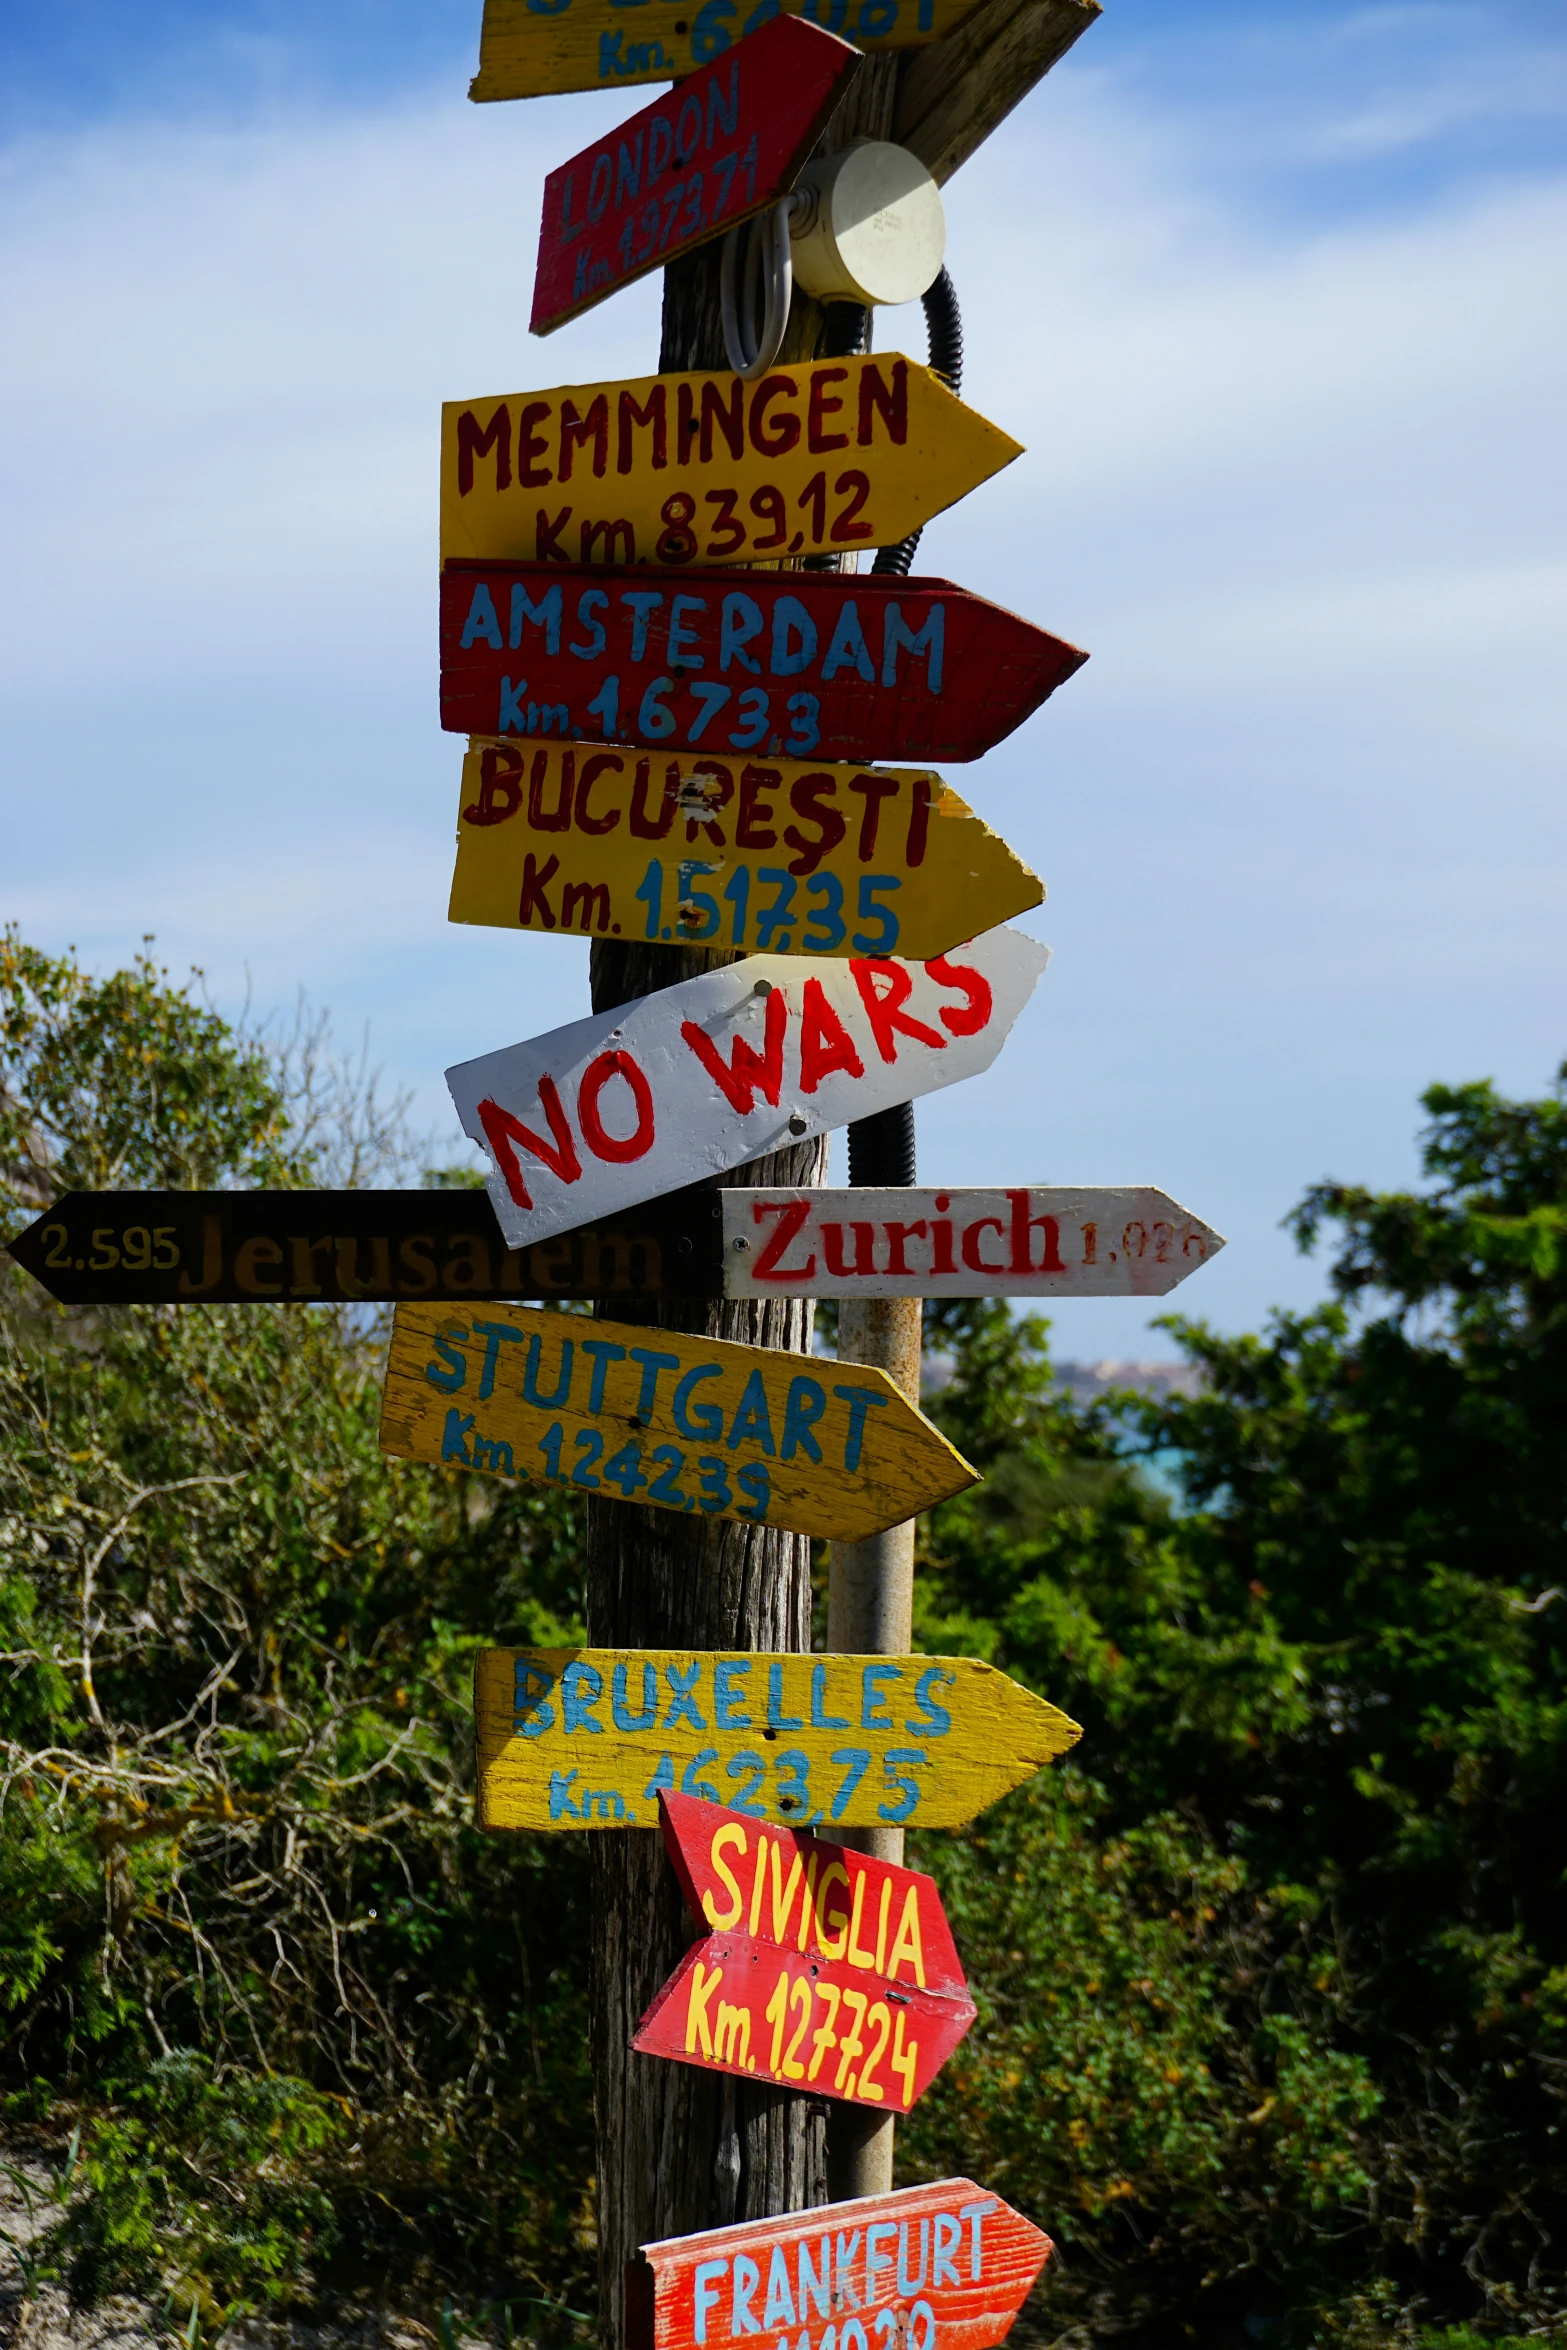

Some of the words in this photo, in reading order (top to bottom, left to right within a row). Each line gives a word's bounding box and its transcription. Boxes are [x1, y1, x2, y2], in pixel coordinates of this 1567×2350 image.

[599, 29, 675, 79] Km.
[561, 58, 739, 246] LONDON
[573, 245, 615, 301] Km.
[618, 132, 759, 271] 1.973,71
[456, 359, 908, 498] MEMMINGEN
[536, 506, 648, 564] Km.
[655, 469, 875, 565] 839,12
[460, 582, 946, 695] AMSTERDAM
[499, 675, 583, 736] Km.
[586, 674, 821, 756] 1.673,3
[518, 852, 622, 934] Km.
[635, 858, 901, 954] 1.517,35
[477, 1050, 655, 1210] NO
[681, 939, 993, 1116] WARS
[40, 1223, 181, 1271] 2.595
[751, 1188, 1066, 1280] Zurich
[427, 1315, 888, 1474] STUTTGART
[441, 1408, 529, 1479] Km.
[538, 1421, 770, 1521] 1.242,39
[513, 1656, 956, 1738] BRUXELLES
[549, 1768, 636, 1822] Km.
[702, 1822, 926, 1988] SIVIGLIA
[685, 1962, 755, 2072] Km.
[694, 2199, 998, 2345] FRANKFURT
